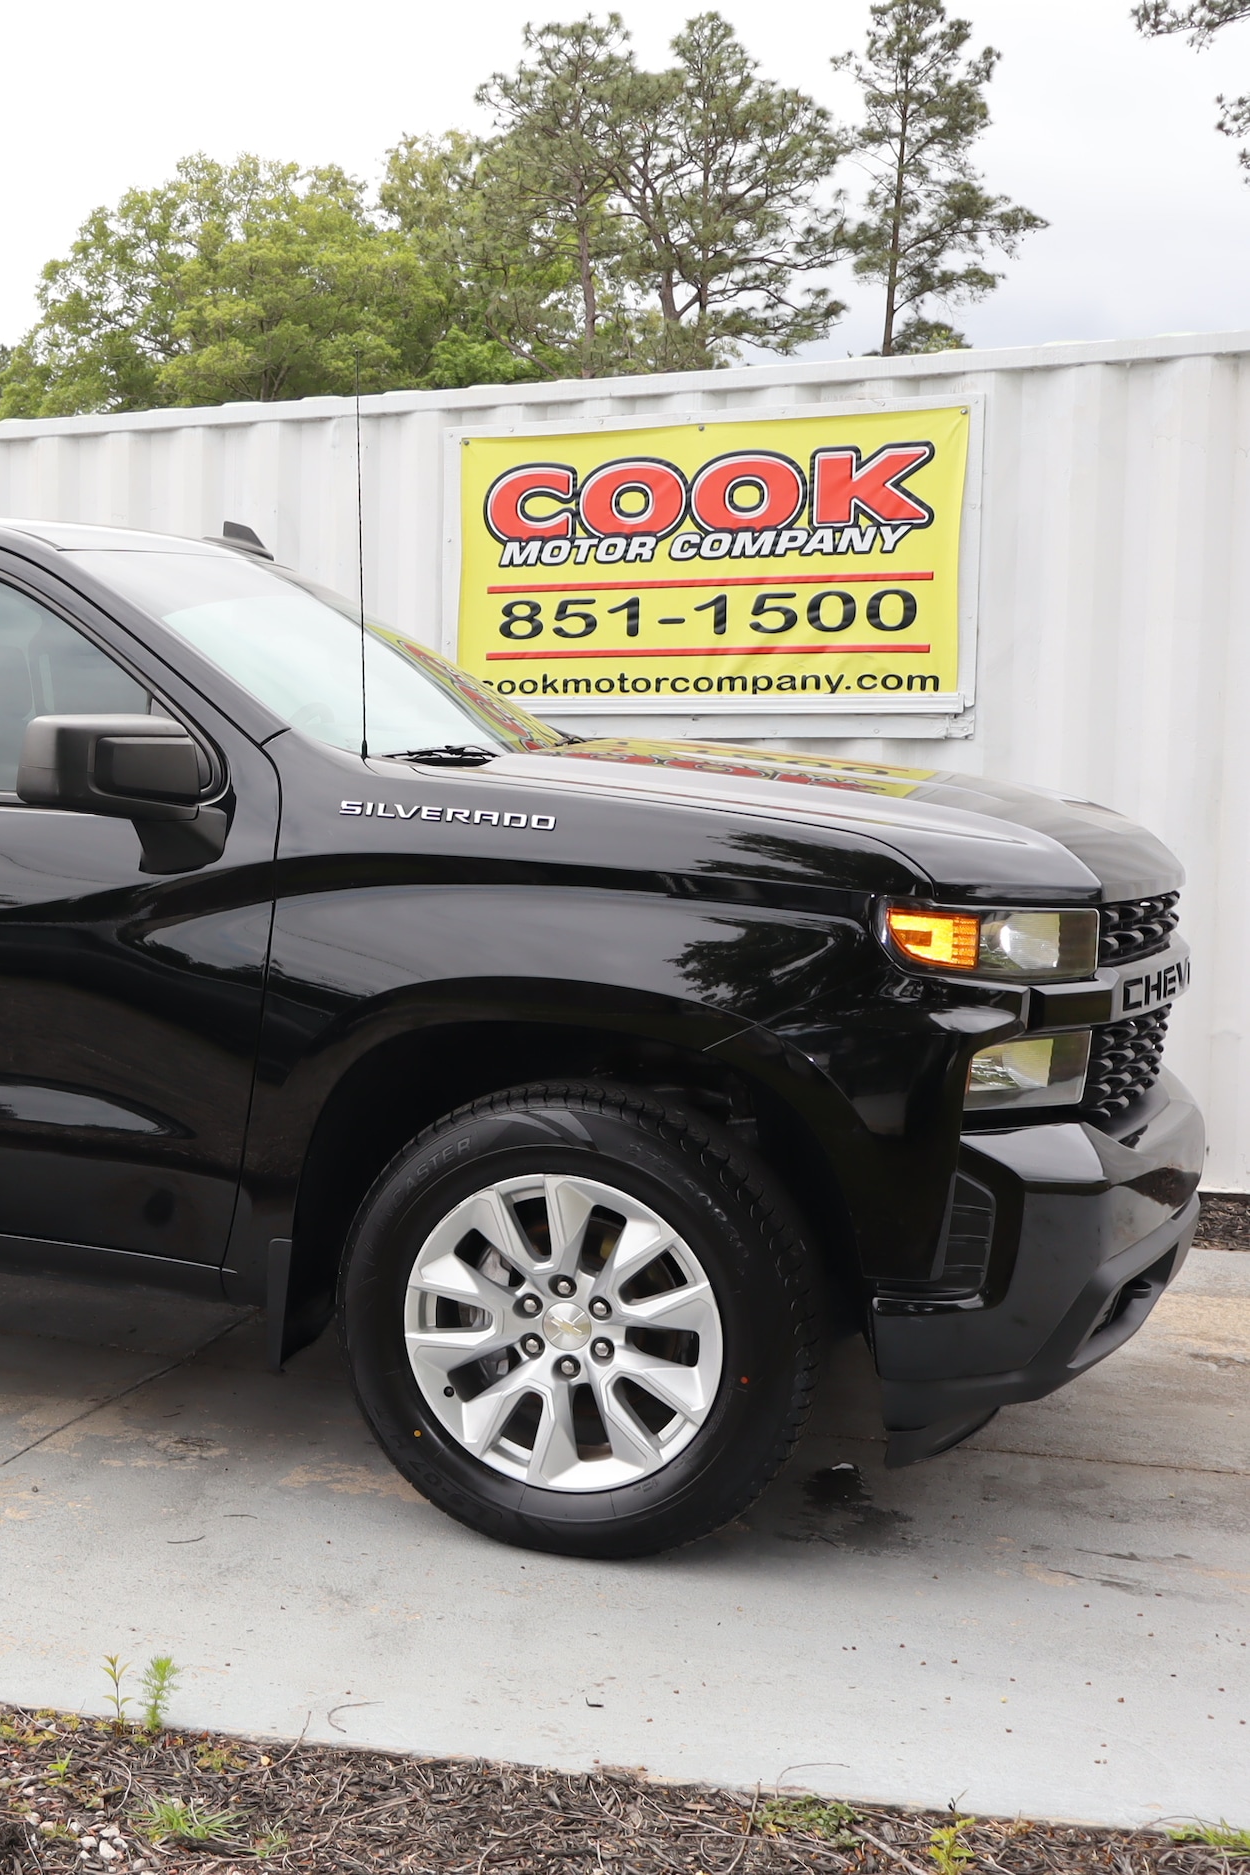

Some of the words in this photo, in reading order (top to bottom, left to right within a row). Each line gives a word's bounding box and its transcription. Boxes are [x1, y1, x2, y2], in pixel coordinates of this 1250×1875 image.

[484, 440, 934, 543] COOK
[498, 534, 658, 567] MOTOR
[668, 524, 914, 560] COMPANY
[499, 590, 918, 639] 851-1500
[339, 800, 557, 831] SILVERADO
[1122, 956, 1190, 1012] CHEV
